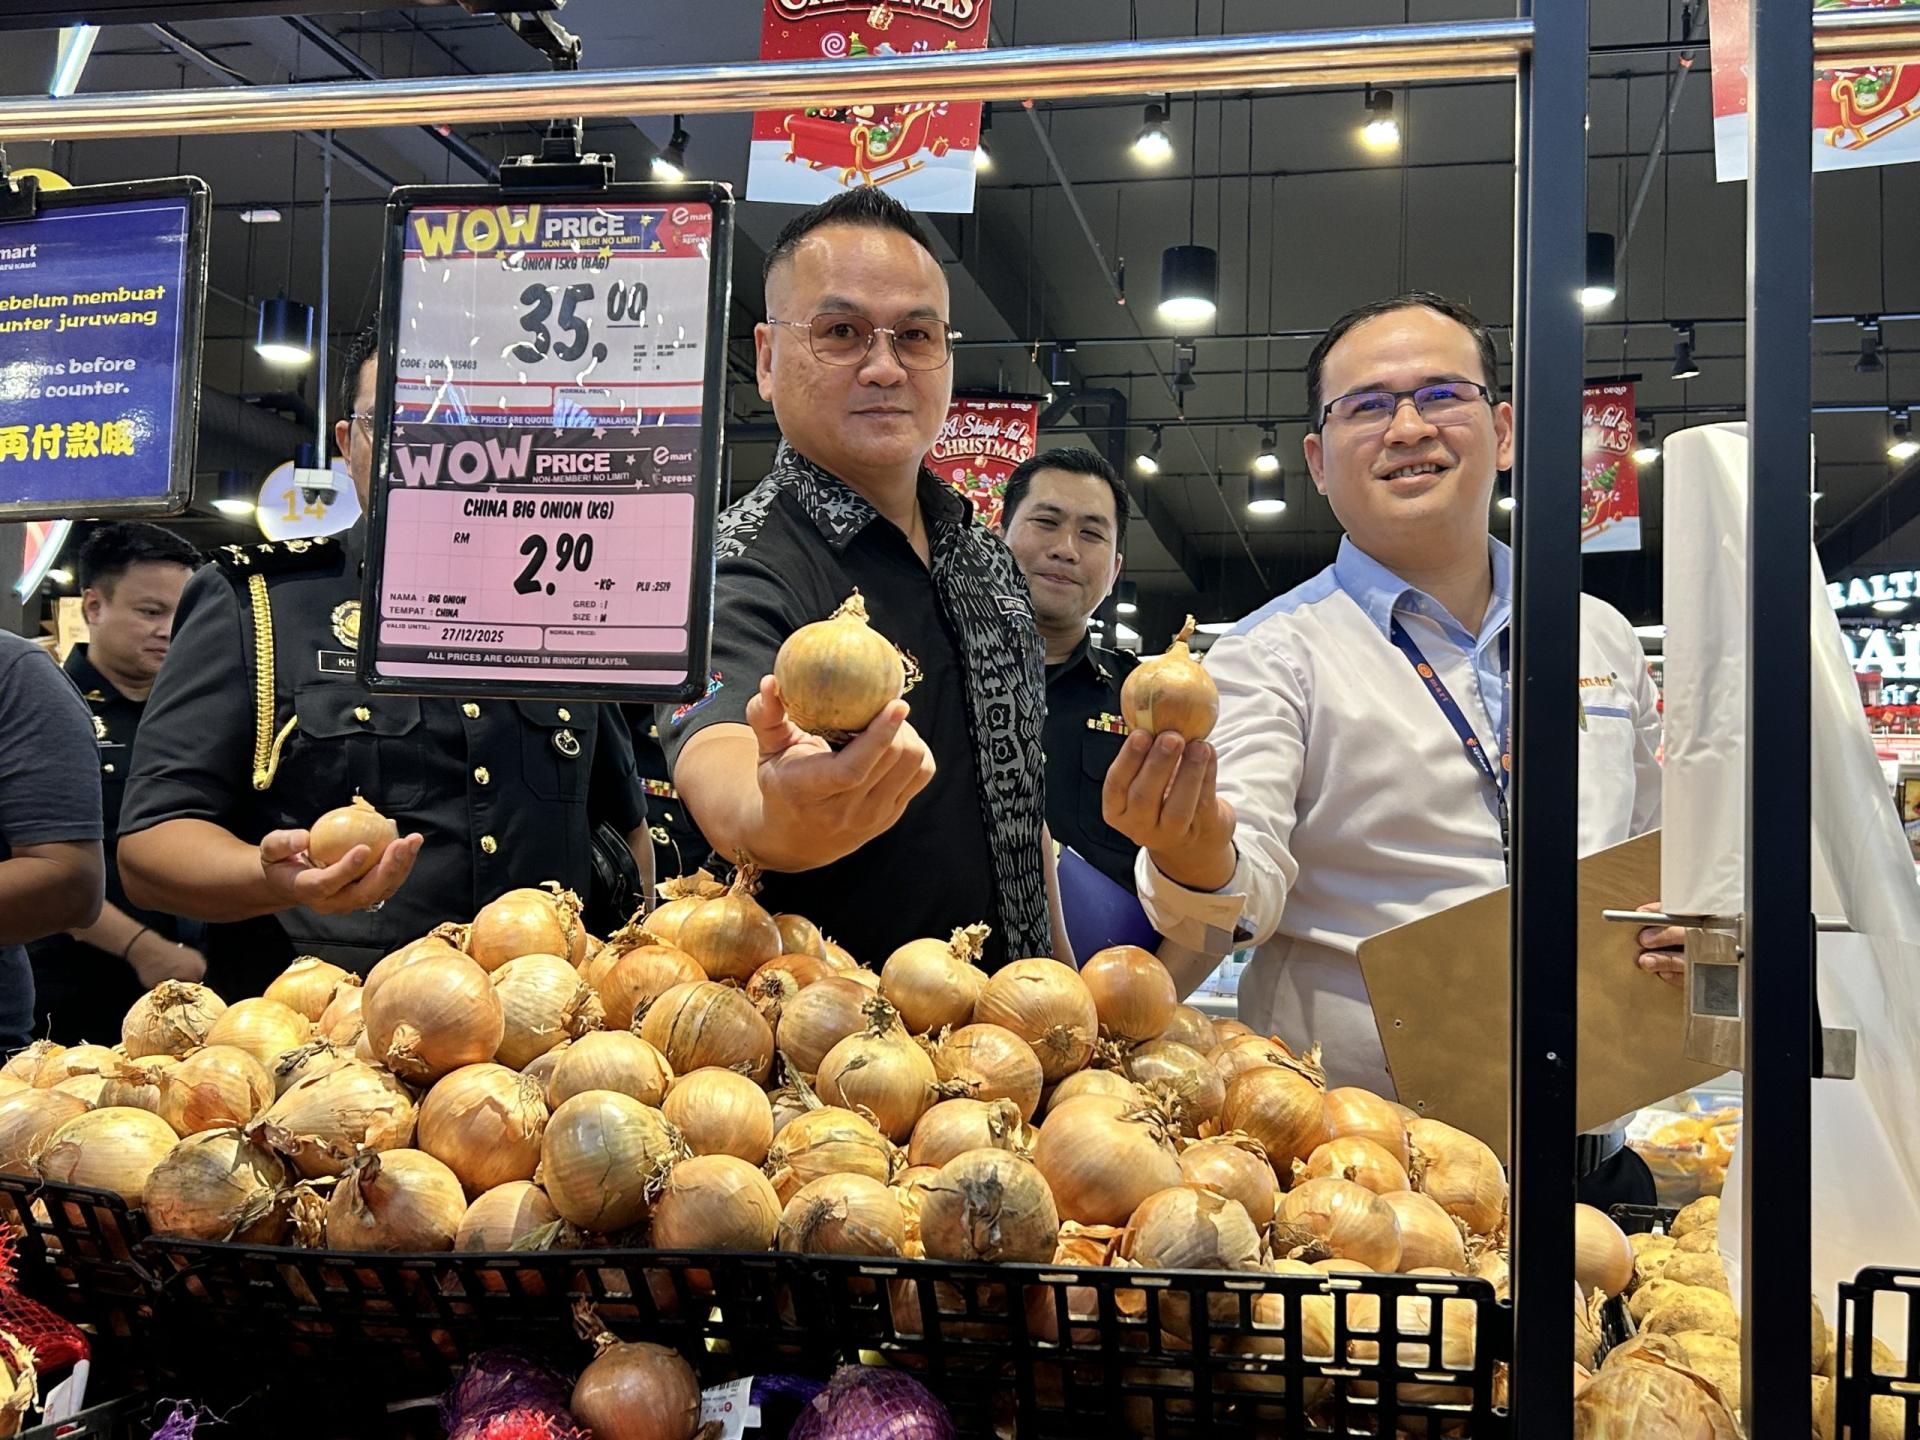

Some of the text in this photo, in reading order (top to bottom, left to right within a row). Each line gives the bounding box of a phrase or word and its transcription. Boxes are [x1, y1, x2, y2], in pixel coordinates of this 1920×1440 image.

[414, 204, 625, 258] WOW PRICE
[602, 237, 614, 245] NO
[521, 257, 552, 271] ONION
[72, 285, 166, 306] membuat
[56, 310, 158, 332] juruwang
[68, 357, 136, 374] before
[400, 358, 421, 368] CODE
[45, 381, 130, 398] counter.
[481, 416, 507, 424] PRICES
[509, 416, 524, 424] ARE
[931, 438, 1029, 463] CHRISTMAS
[397, 434, 611, 487] WOW PRICE
[532, 471, 630, 484] NON-MEMBER! NO LIMIT!
[463, 498, 615, 520] CHINA BIG ONION (KG)
[453, 532, 471, 545] RM
[636, 581, 650, 592] PLU
[390, 593, 467, 605] NAMA BIG ONION
[573, 600, 596, 608] GRED
[389, 606, 459, 618] TEMPAT CHINA
[572, 613, 591, 621] SIZE
[441, 628, 504, 643] 27/12/2025
[427, 652, 445, 660] ALL
[447, 653, 481, 662] PRICES
[484, 654, 502, 663] ARE
[541, 656, 551, 664] IN
